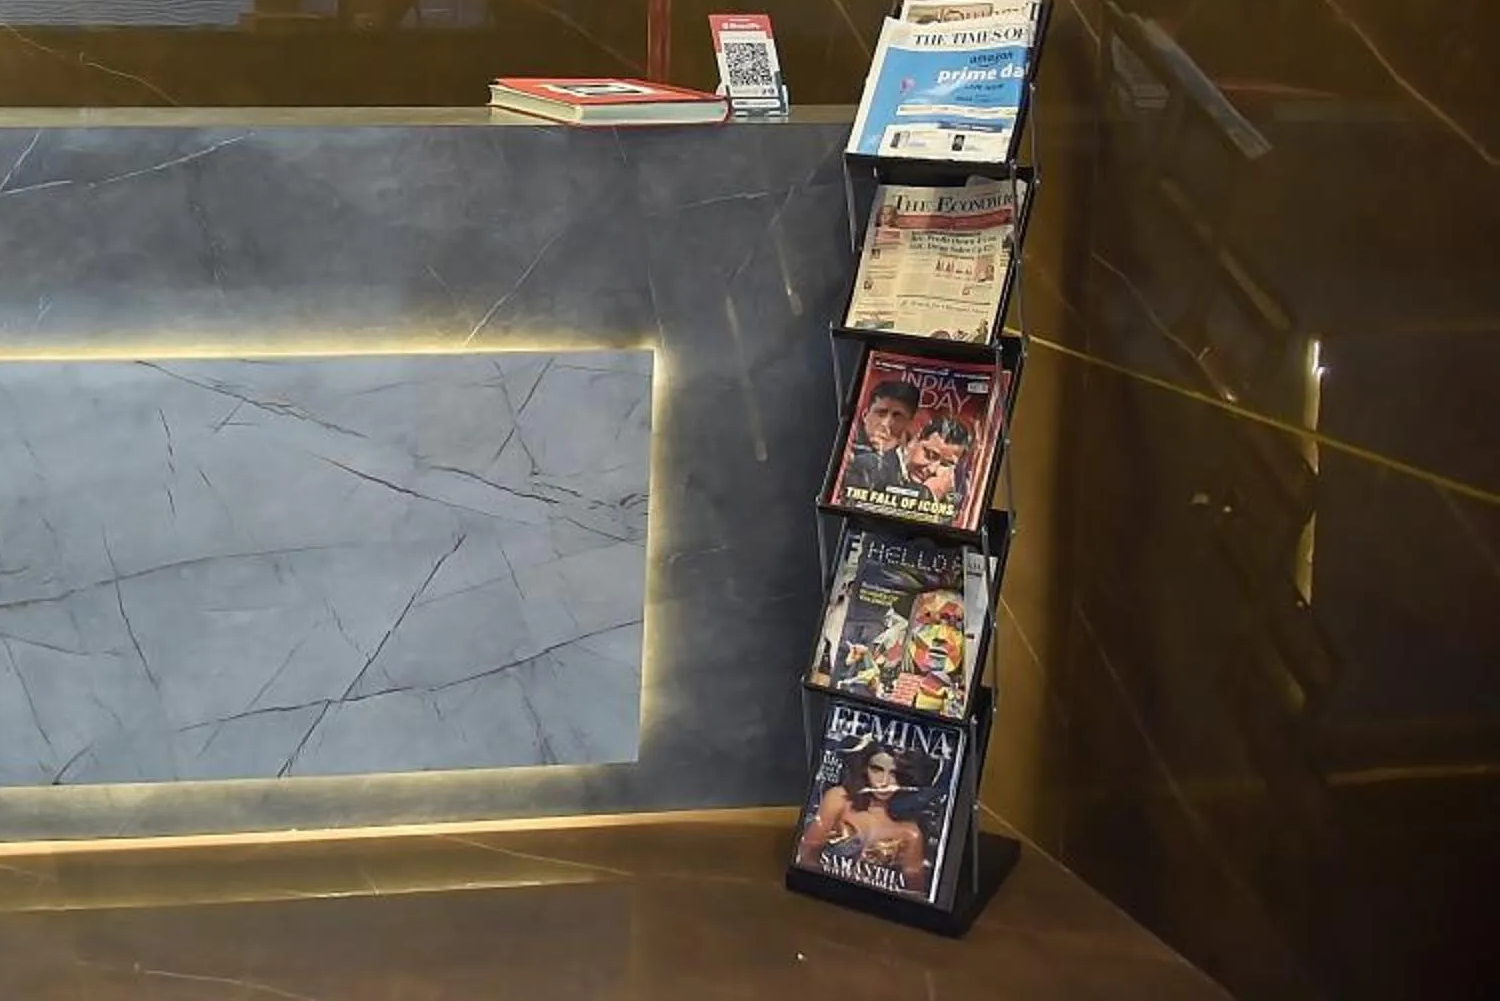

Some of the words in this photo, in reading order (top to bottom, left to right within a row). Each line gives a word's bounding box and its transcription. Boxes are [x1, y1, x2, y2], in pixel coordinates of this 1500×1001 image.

[914, 32, 944, 45] THE
[952, 29, 1001, 45] TIMES
[969, 52, 1013, 65] amazon
[937, 66, 997, 83] prime
[901, 370, 957, 392] INDIA
[846, 487, 868, 501] THE
[870, 491, 897, 507] FALL
[901, 497, 916, 510] OF
[918, 500, 954, 516] ICONS
[829, 706, 951, 759] FEMINA
